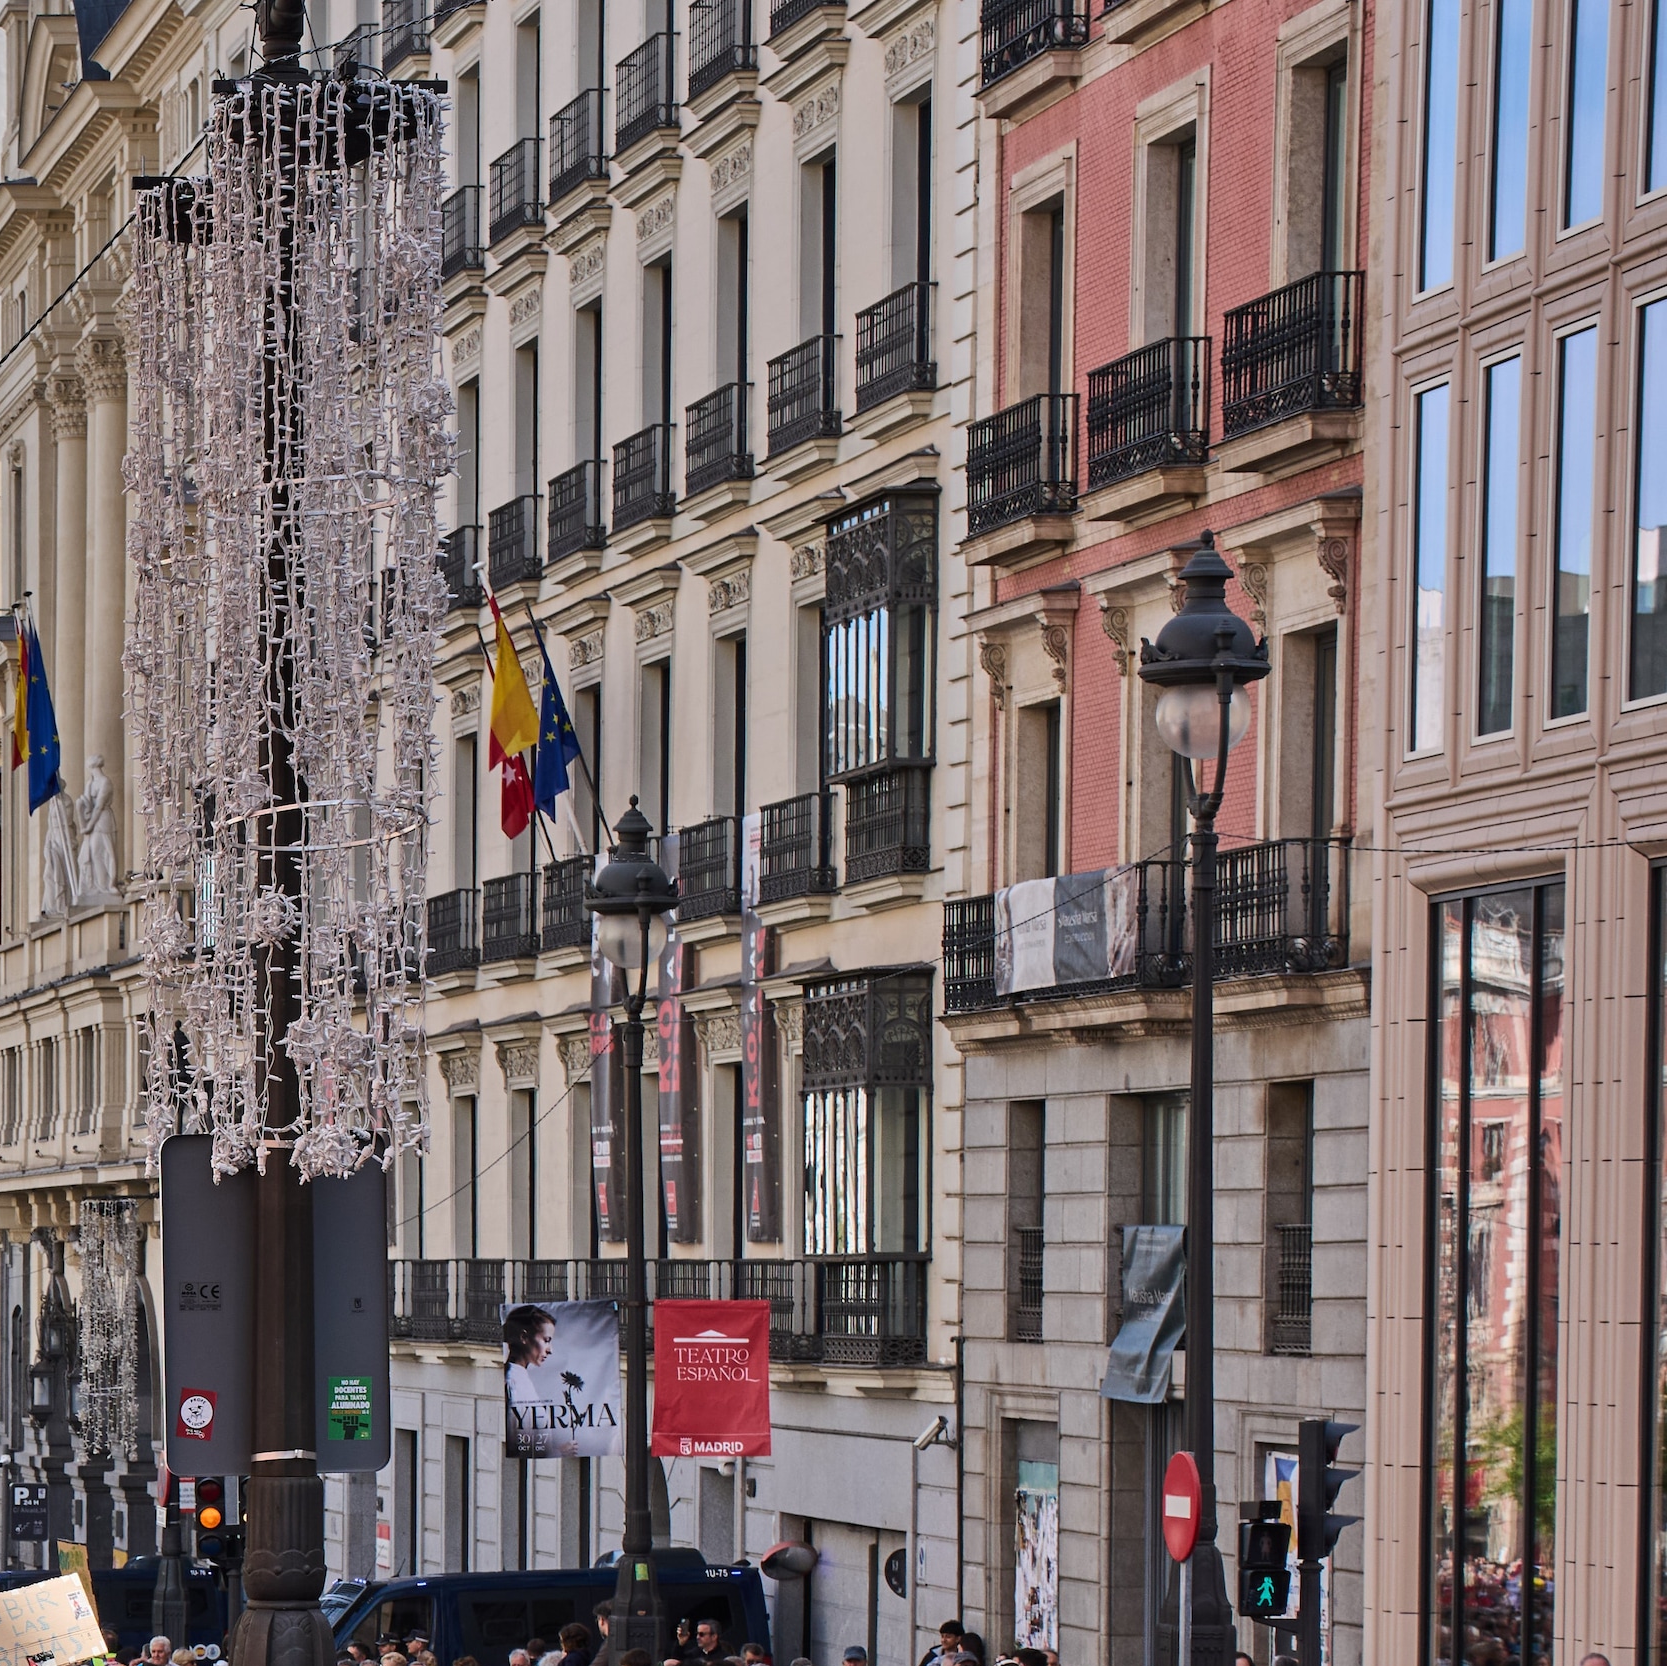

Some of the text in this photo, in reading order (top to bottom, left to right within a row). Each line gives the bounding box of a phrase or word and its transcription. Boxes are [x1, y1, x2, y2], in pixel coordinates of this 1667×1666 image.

[674, 1348, 749, 1365] TEATRO
[677, 1364, 760, 1382] ESPAÑOL
[334, 1386, 367, 1394] DOCENTES
[511, 1403, 617, 1430] YERMA
[518, 1433, 549, 1446] 30 27
[694, 1441, 743, 1455] MADRID
[14, 1487, 30, 1505] P
[705, 1569, 729, 1578] 1U-75
[12, 1614, 52, 1636] LAS
